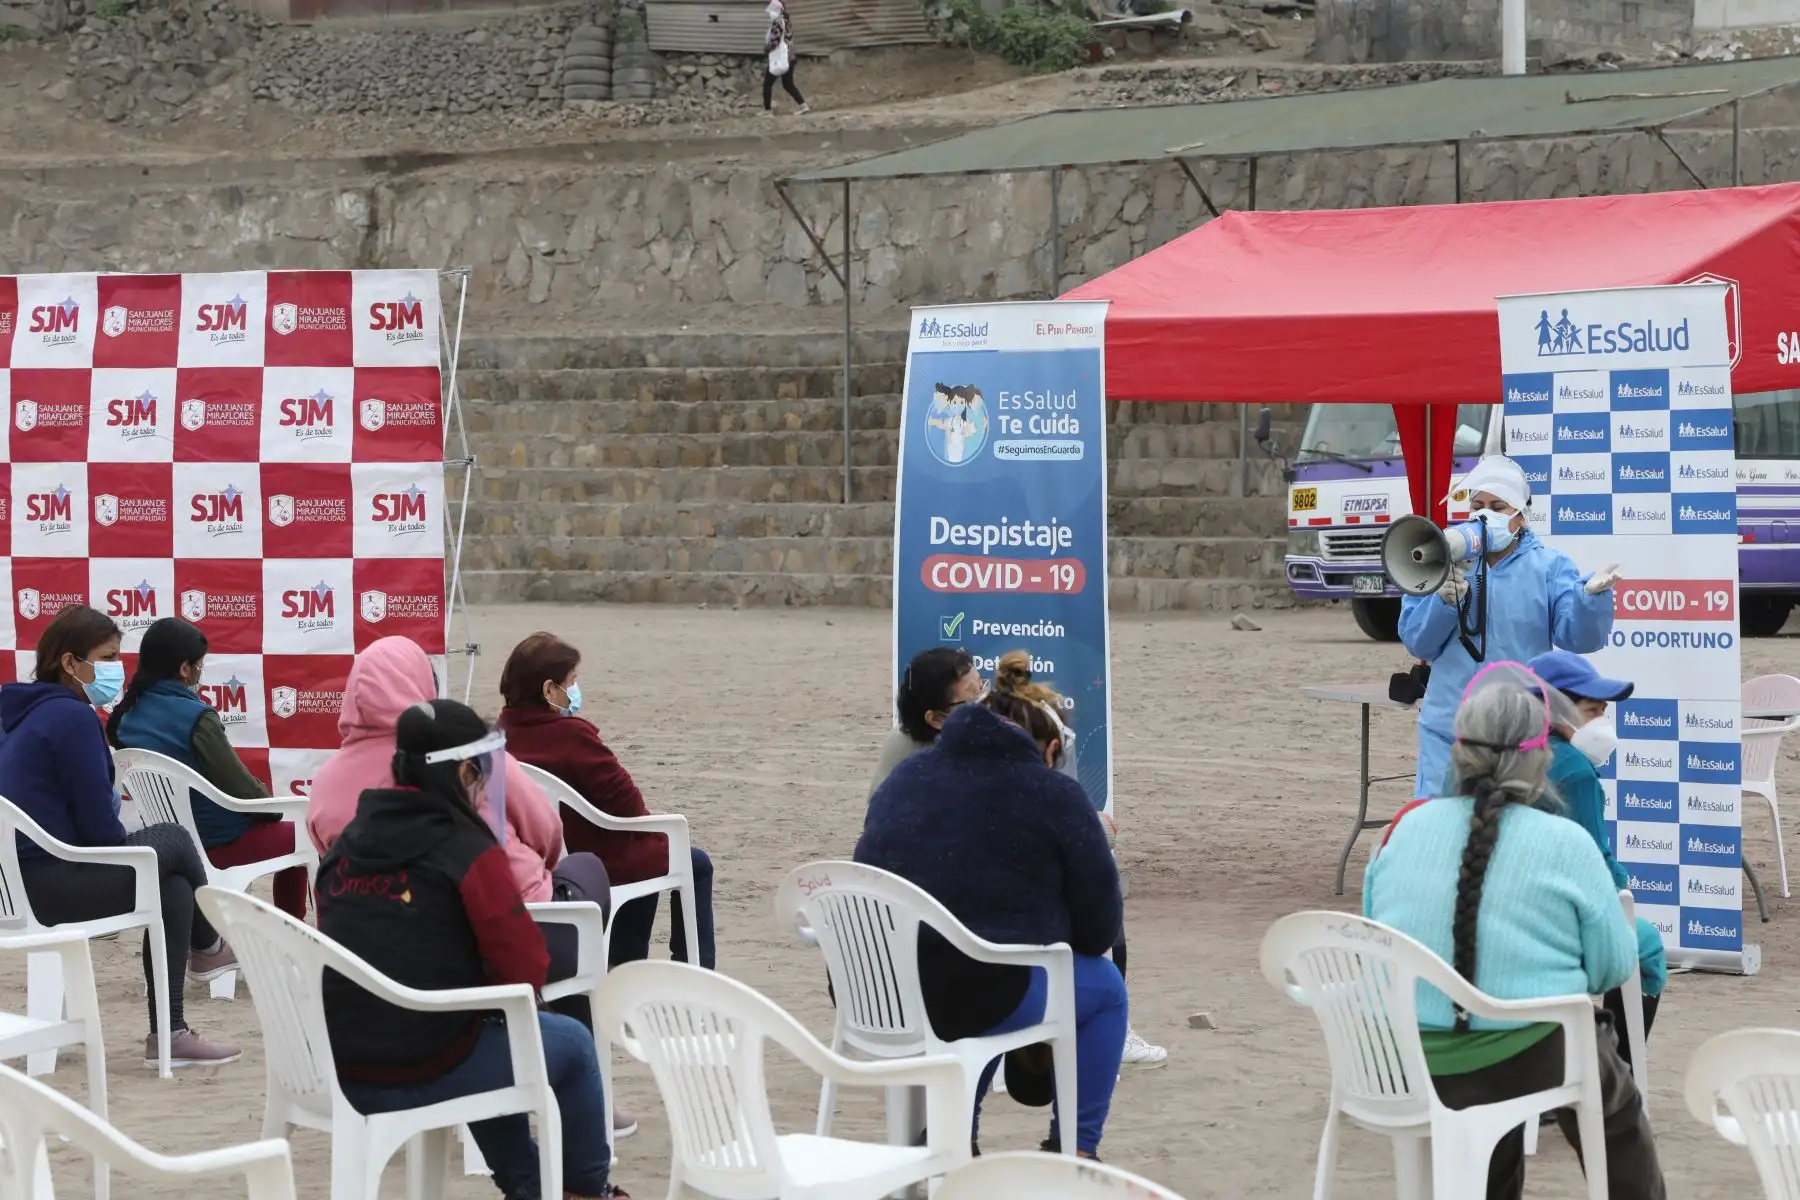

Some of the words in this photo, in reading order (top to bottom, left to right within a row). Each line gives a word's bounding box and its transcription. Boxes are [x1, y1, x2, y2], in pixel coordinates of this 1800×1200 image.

[30, 306, 79, 332] SJM
[196, 304, 247, 331] SJM
[370, 303, 423, 330] SJM
[944, 322, 988, 338] EsSalud
[1587, 317, 1689, 354] EsSalud
[1574, 388, 1603, 399] EsSalud
[1634, 386, 1662, 397] EsSalud
[1694, 385, 1724, 395] EsSalud
[1523, 391, 1548, 401] EsSalud
[107, 400, 156, 426] SJM
[280, 398, 333, 426] SJM
[998, 416, 1022, 434] Te
[1029, 414, 1079, 434] Cuida
[1525, 432, 1548, 441] EsSalud
[1574, 429, 1603, 440] EsSalud
[1636, 427, 1663, 438] EsSalud
[1697, 426, 1727, 436] EsSalud
[998, 445, 1080, 456] #SeguimosEnGuardia
[1576, 470, 1604, 480] EsSalud
[1636, 469, 1664, 479] EsSalud
[1697, 468, 1728, 478] EsSalud
[1295, 494, 1316, 508] 9802
[26, 494, 71, 521] SJM
[191, 493, 243, 521] SJM
[372, 493, 426, 521] SJM
[1576, 511, 1605, 521] EsSalud
[1638, 511, 1666, 520] EsSalud
[1697, 510, 1730, 520] EsSalud
[226, 523, 242, 531] todos
[930, 517, 1072, 555] Despistaje
[932, 562, 1022, 589] COVID
[1050, 565, 1075, 590] 19
[106, 590, 156, 616] SJM
[245, 595, 256, 603] DE
[282, 590, 334, 618] SJM
[1623, 590, 1685, 610] COVID
[1704, 591, 1729, 611] 19
[298, 620, 307, 628] Es
[317, 619, 333, 627] todos
[972, 619, 1064, 637] Prevención
[1631, 632, 1733, 648] OPORTUNO
[1640, 717, 1671, 726] EsSalud
[1700, 719, 1733, 728] EsSalud
[1642, 758, 1671, 768] EsSalud
[1702, 760, 1734, 770] EsSalud
[1641, 799, 1672, 809] EsSalud
[1703, 801, 1733, 812] EsSalud
[1642, 840, 1672, 850] EsSalud
[1705, 844, 1734, 854] EsSalud
[1642, 881, 1672, 891] EsSalud
[1704, 885, 1734, 895] EsSalud
[1705, 926, 1736, 937] EsSalud
